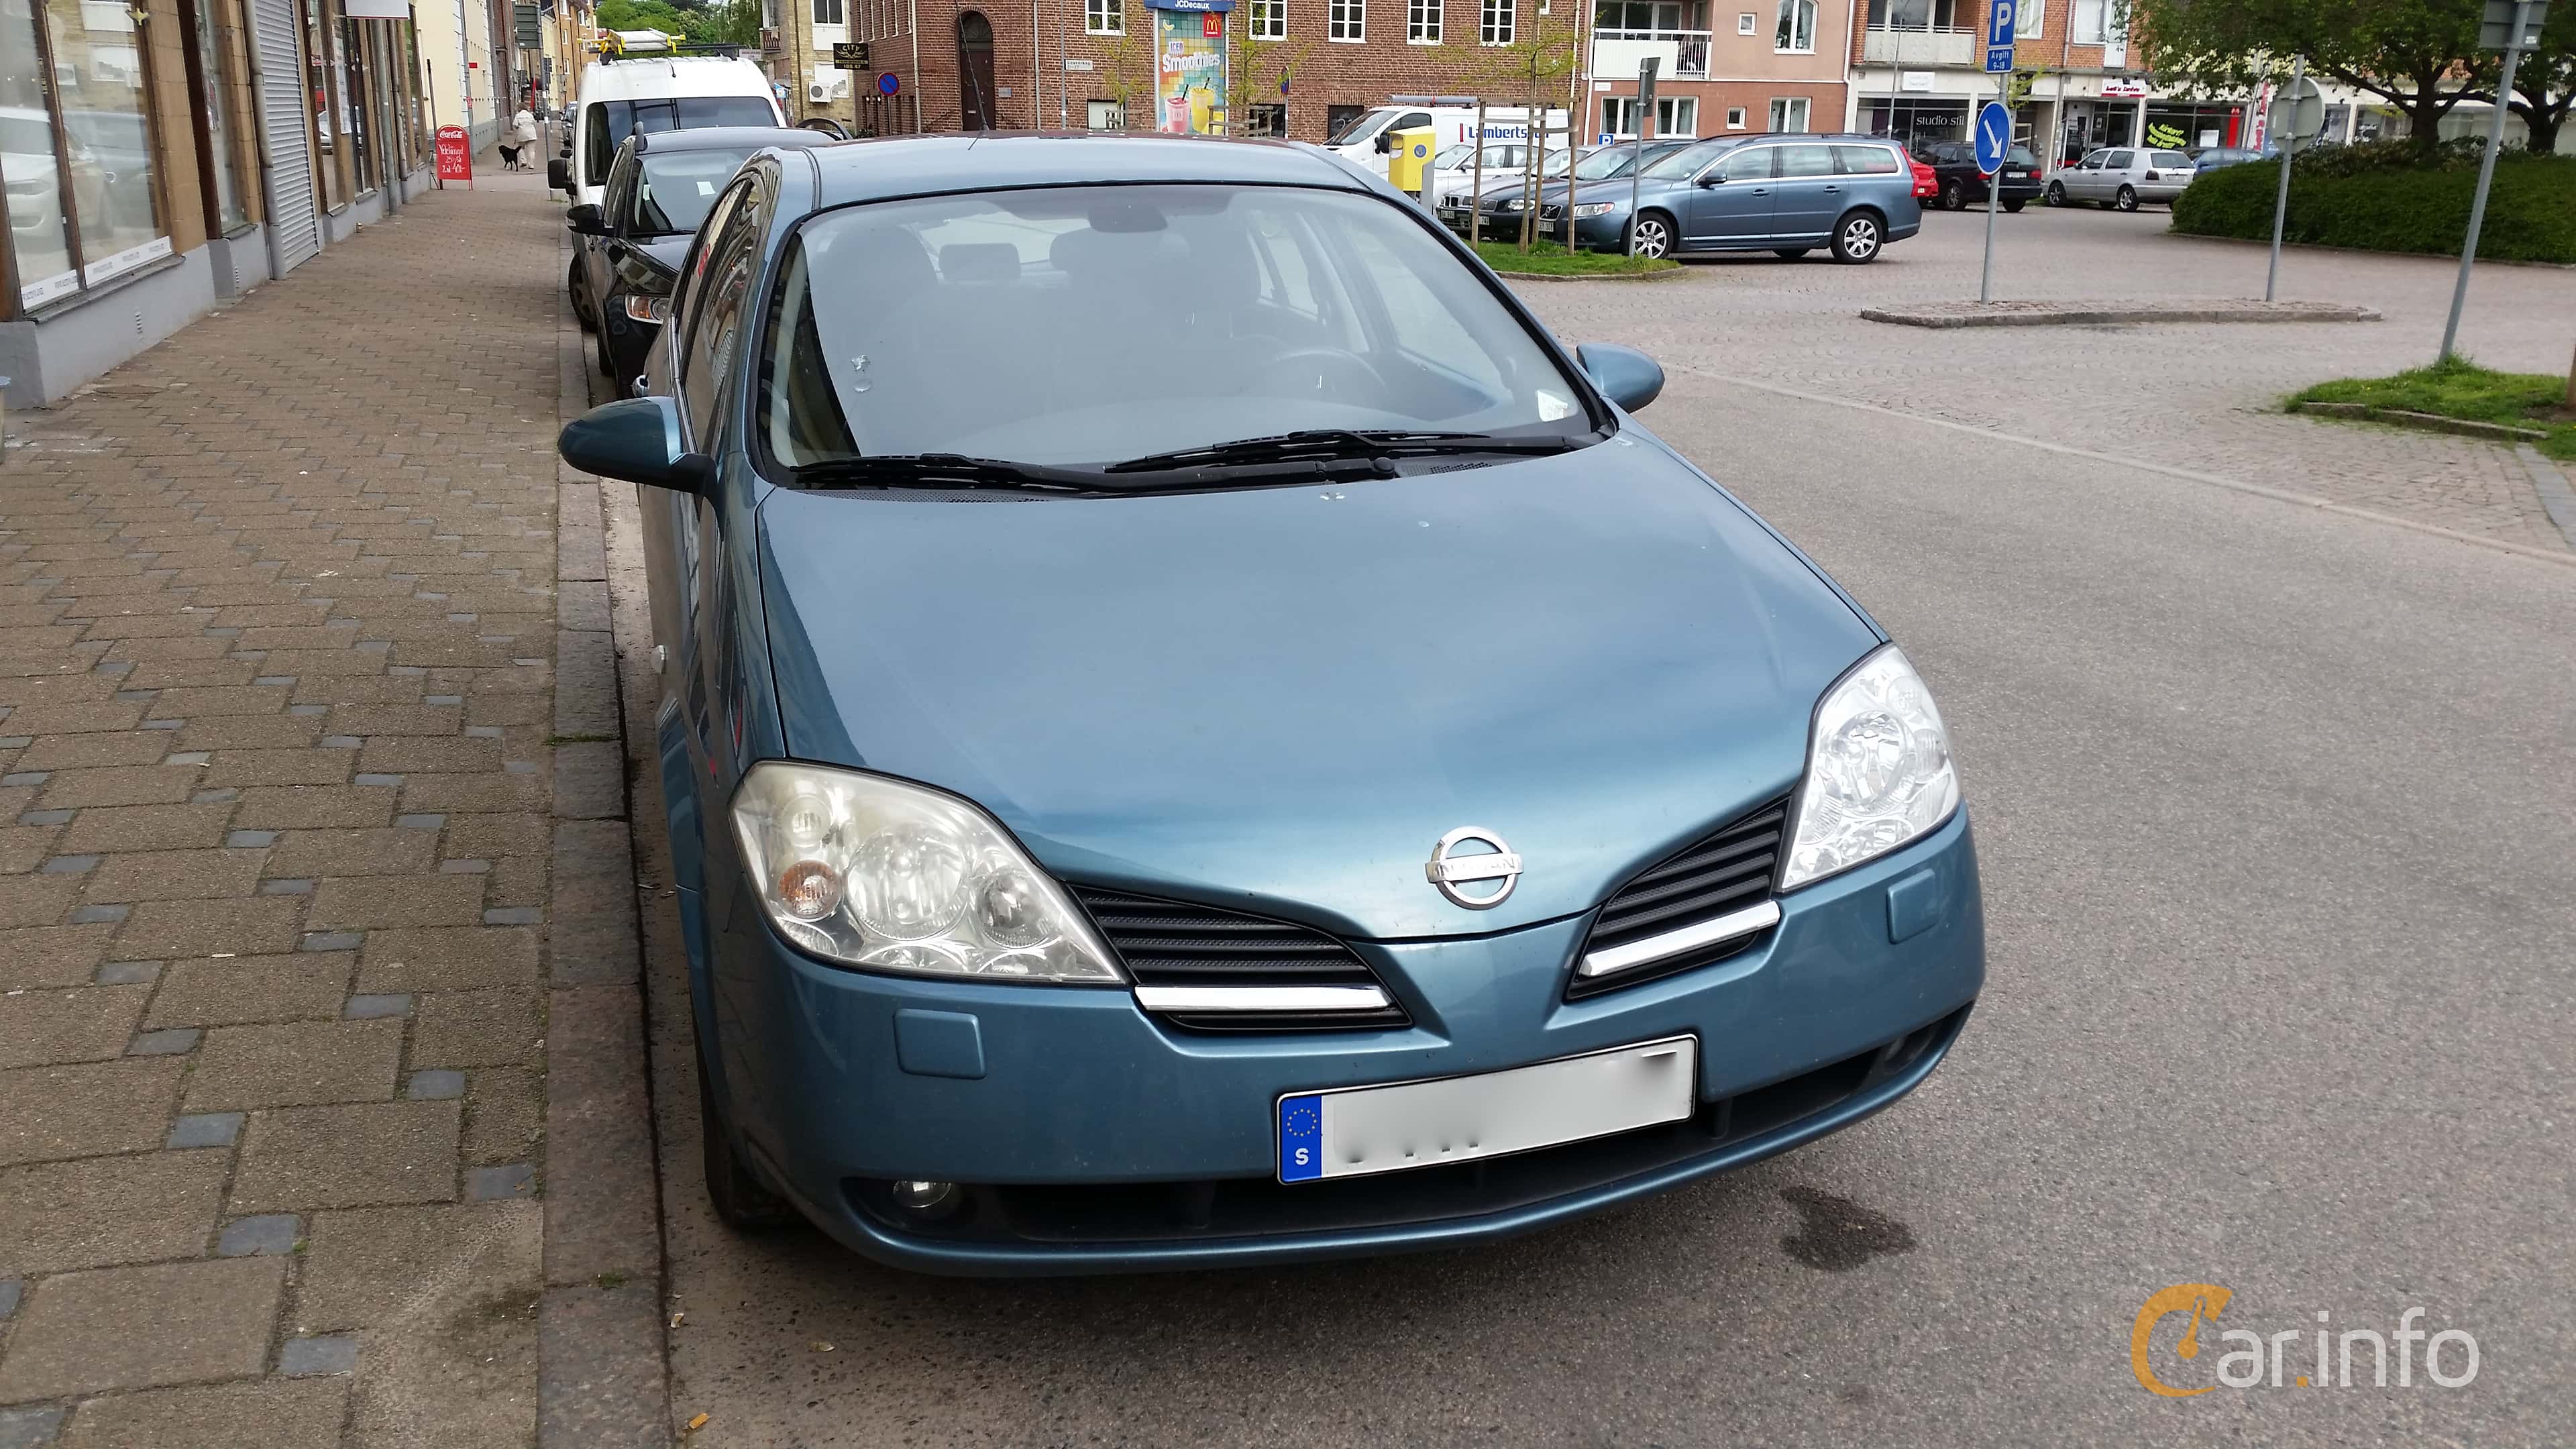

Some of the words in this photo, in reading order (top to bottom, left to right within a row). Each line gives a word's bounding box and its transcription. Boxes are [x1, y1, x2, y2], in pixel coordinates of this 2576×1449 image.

[1175, 0, 1210, 9] JCDecaux
[1995, 3, 2011, 42] P
[1170, 42, 1183, 51] ICED
[1991, 50, 2009, 60] Avgift
[1163, 51, 1220, 72] Smoothies
[1992, 61, 2005, 70] 9-18
[1916, 115, 1947, 126] studio
[1949, 115, 1965, 126] stil
[1468, 126, 1549, 139] Lmberts
[1434, 857, 1516, 880] NIAN
[1295, 1148, 1309, 1166] S
